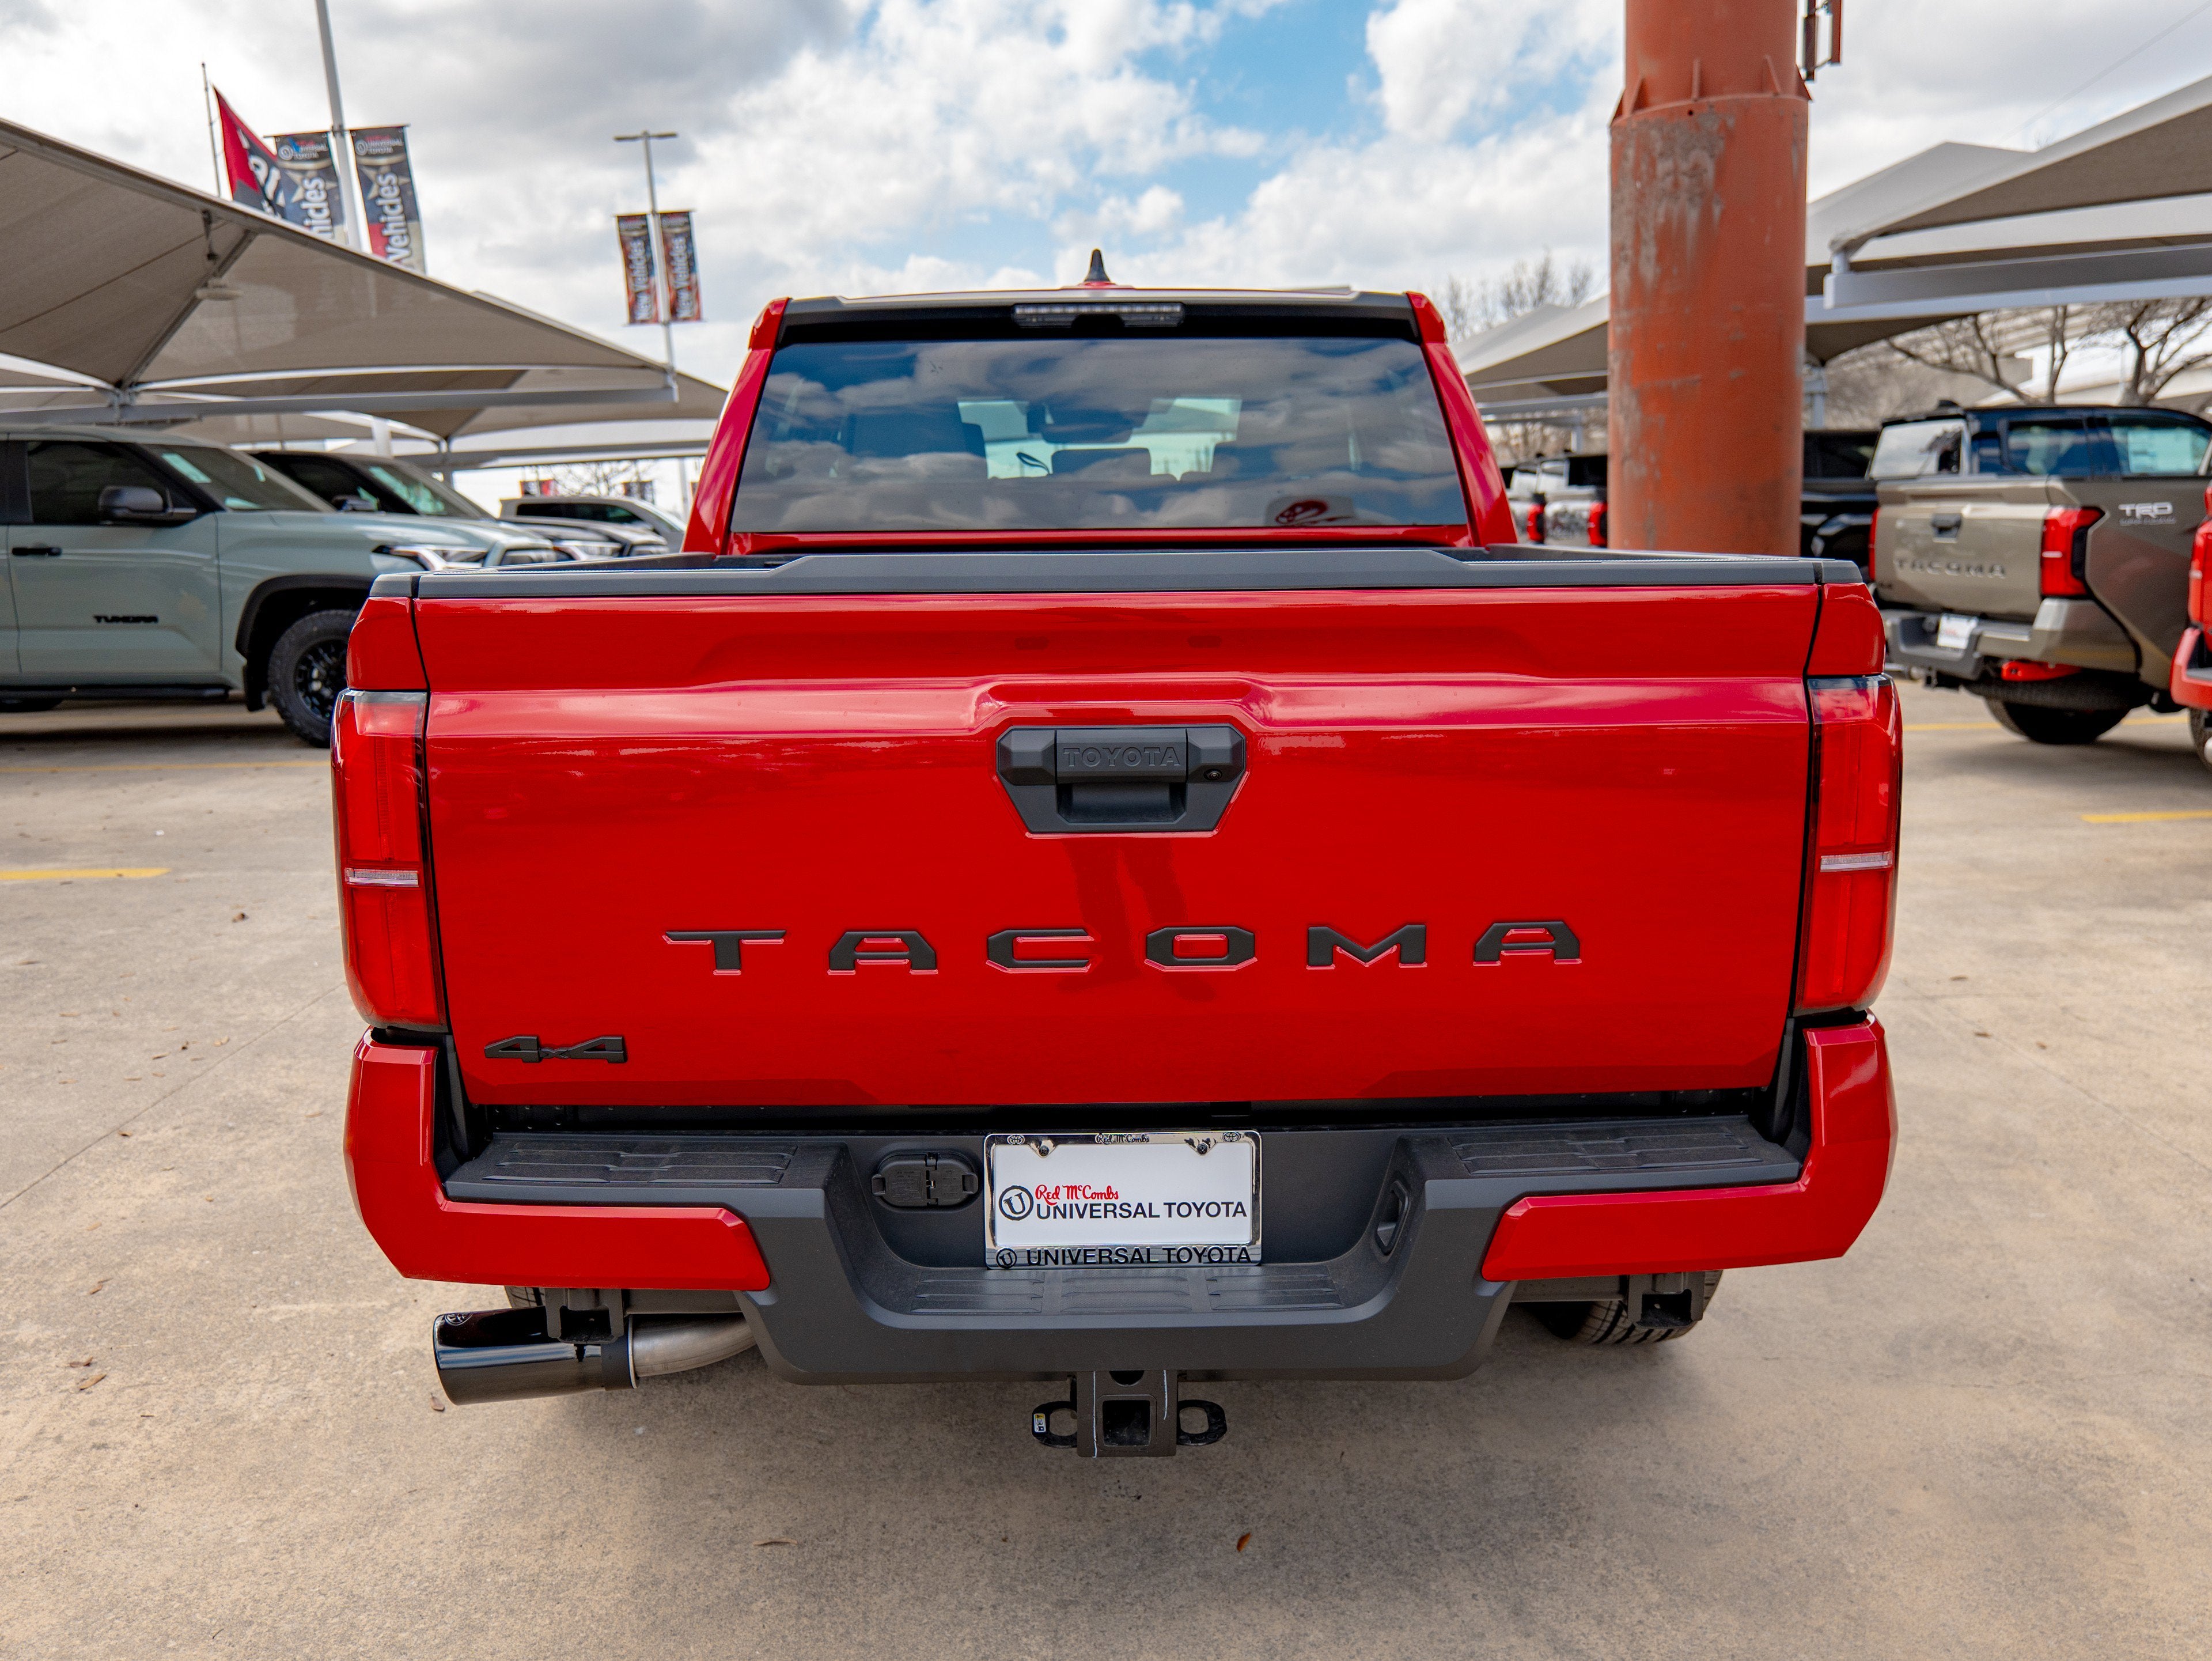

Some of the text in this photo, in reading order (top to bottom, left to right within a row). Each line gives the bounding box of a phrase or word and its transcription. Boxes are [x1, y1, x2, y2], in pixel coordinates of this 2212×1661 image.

[300, 176, 333, 239] hicles
[376, 173, 411, 262] Vehicles
[628, 238, 649, 293] Vehicles
[669, 236, 690, 289] Vehicles
[2118, 501, 2173, 519] TRD
[1894, 557, 2006, 578] TACOMA
[1063, 746, 1180, 767] TOYOTA
[664, 921, 1581, 974] TACOMA
[1095, 1133, 1112, 1145] Red
[1035, 1185, 1119, 1206] Red McCombs
[1036, 1202, 1160, 1219] UNIVERSAL
[1163, 1201, 1248, 1217] TOYOTA
[1027, 1246, 1159, 1265] UNIVERSAL
[1161, 1246, 1252, 1263] TOYOTA
